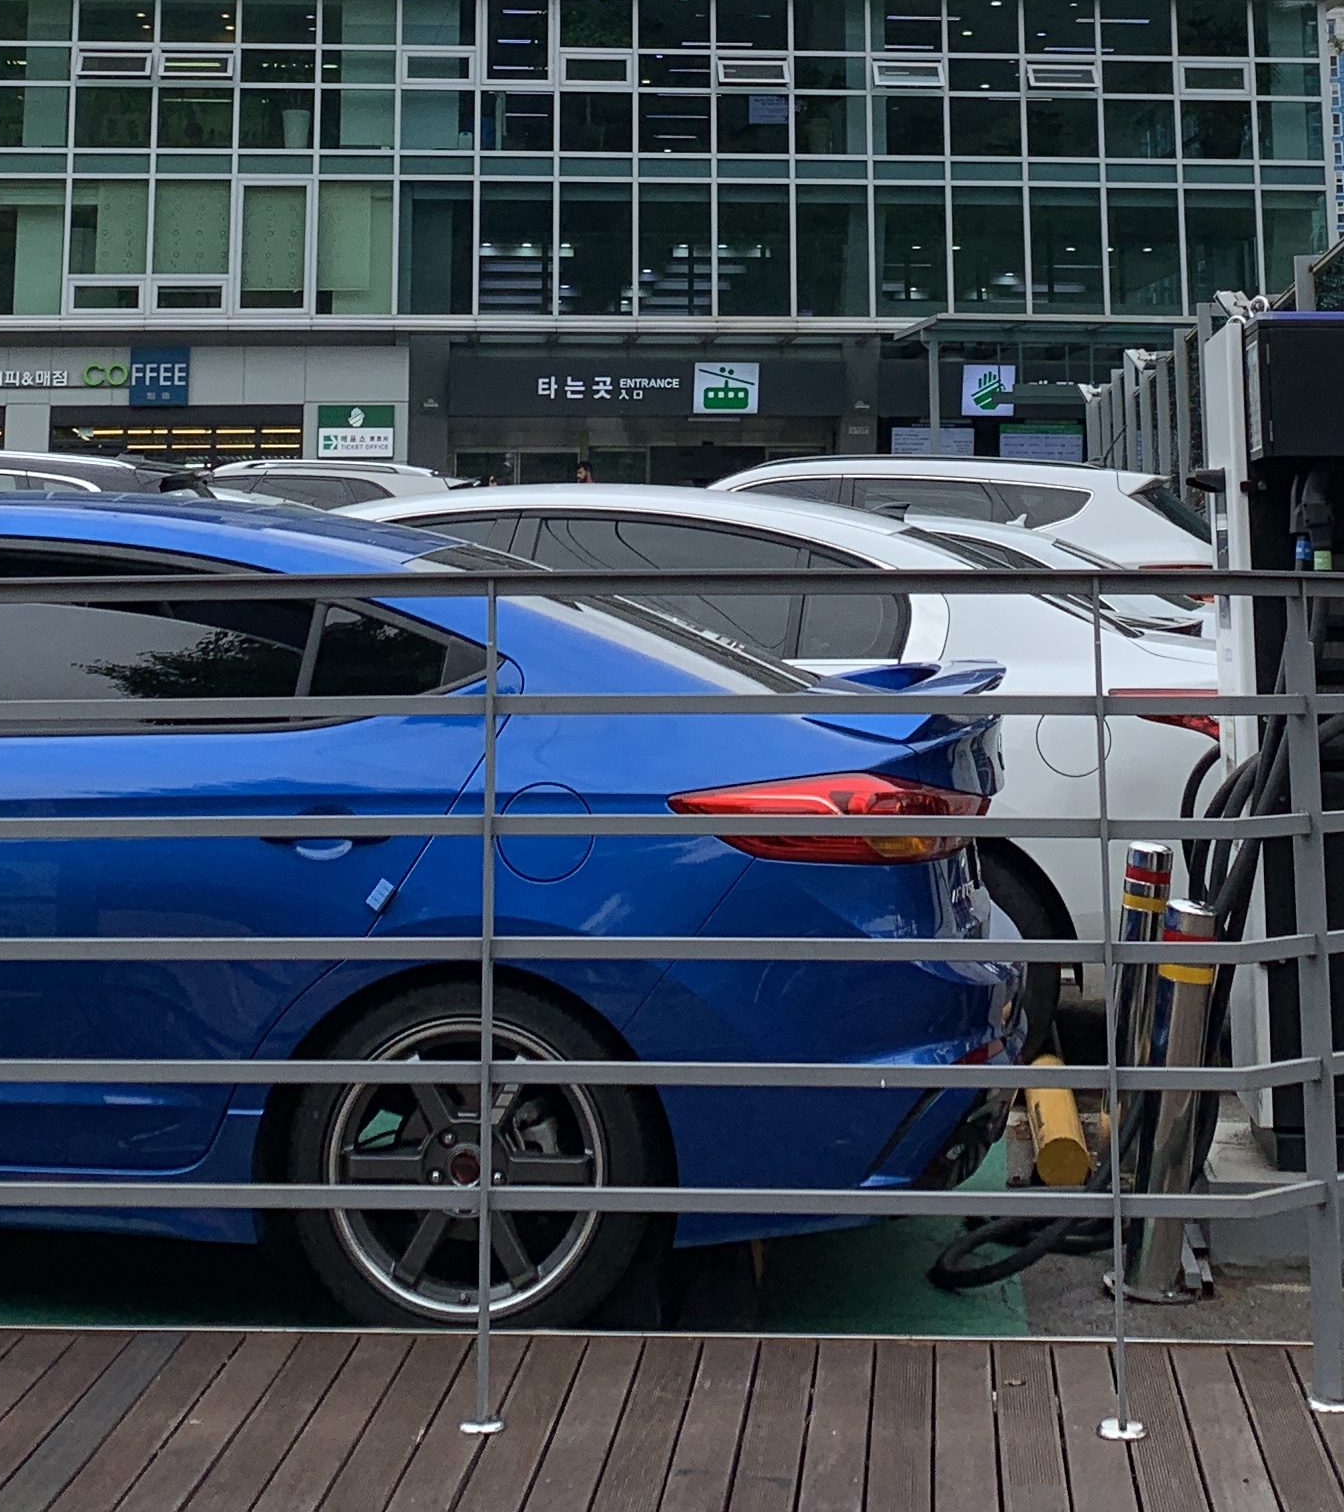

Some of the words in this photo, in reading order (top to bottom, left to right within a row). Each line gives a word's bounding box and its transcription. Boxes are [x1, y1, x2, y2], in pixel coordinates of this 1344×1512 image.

[81, 361, 188, 387] COFFEE
[619, 377, 681, 389] ENTRANCE
[340, 443, 364, 451] TICKET
[365, 443, 389, 451] OFFICE
